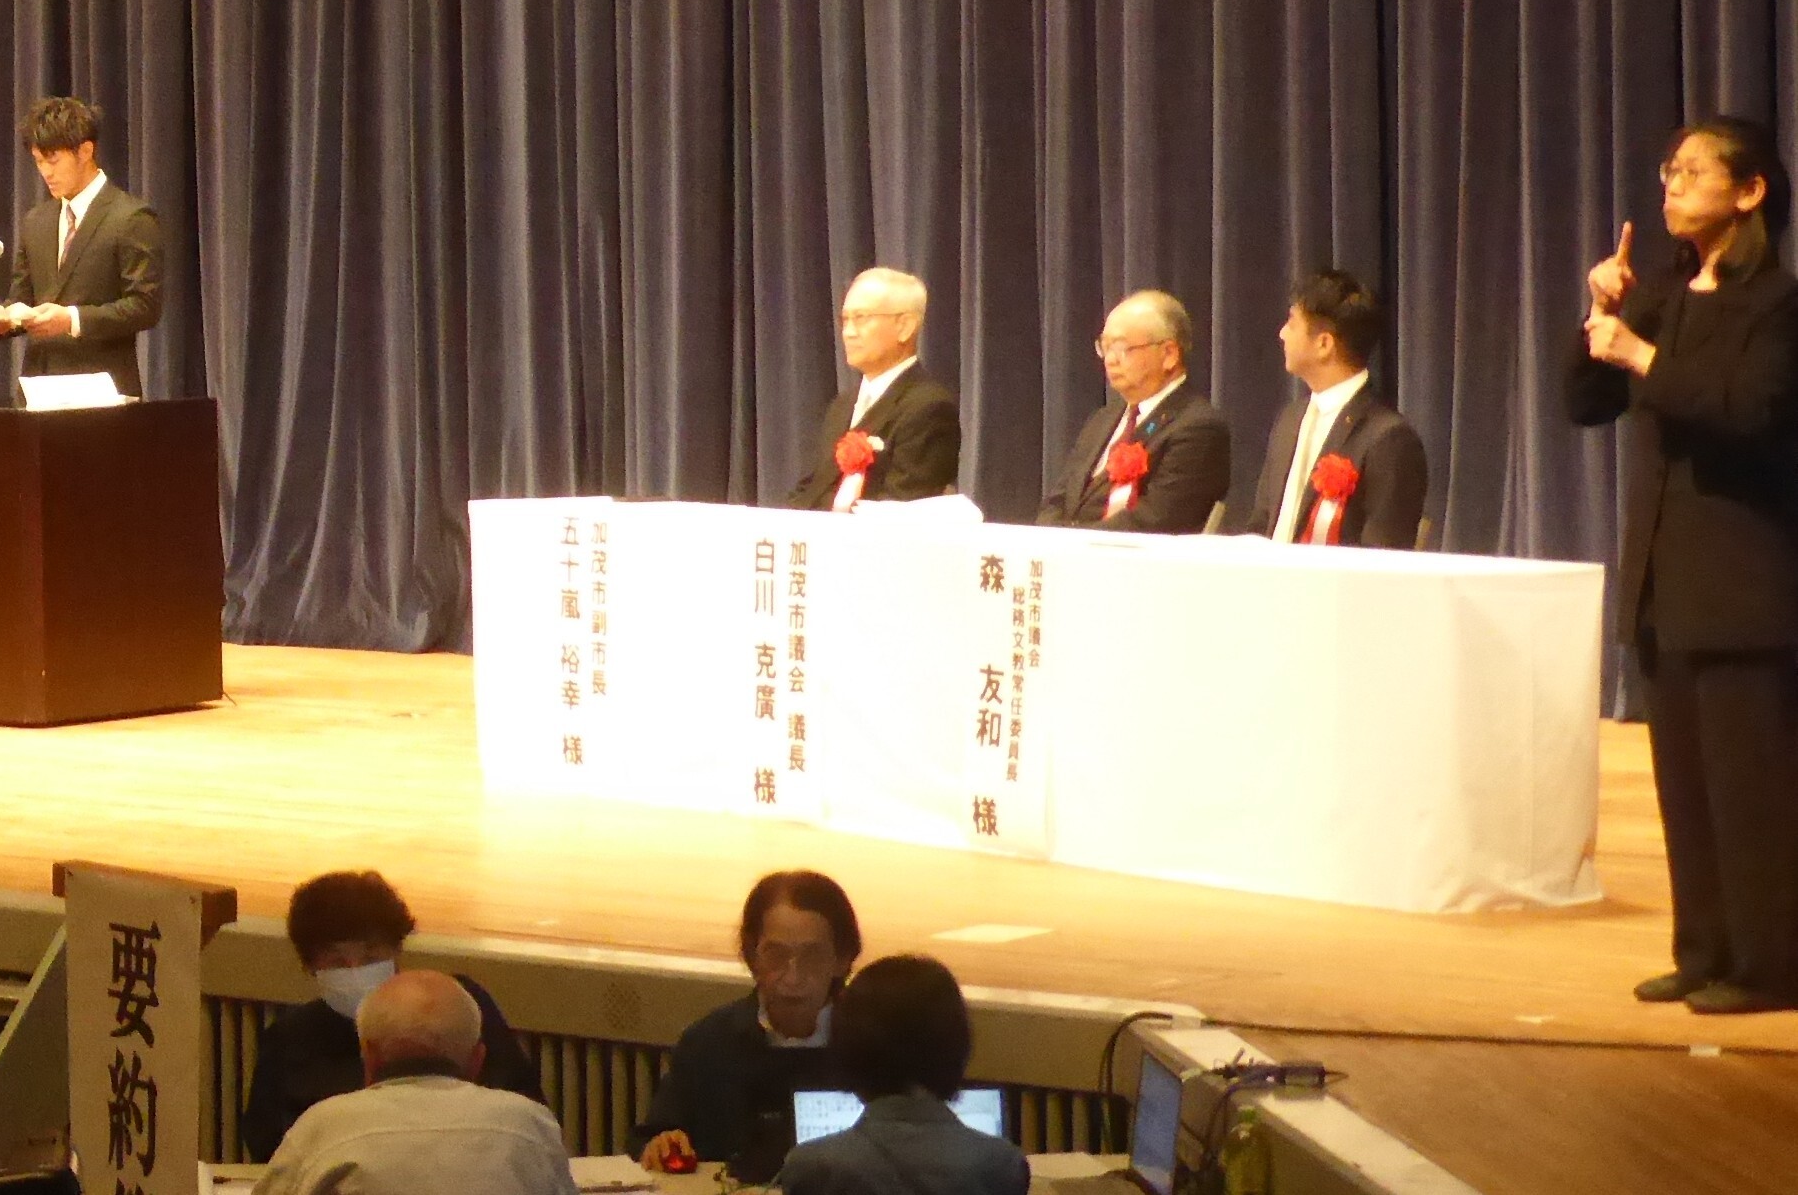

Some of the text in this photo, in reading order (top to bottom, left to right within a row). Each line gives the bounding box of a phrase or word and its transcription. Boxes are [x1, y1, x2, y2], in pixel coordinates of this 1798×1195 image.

[560, 517, 583, 765] 五十嵐 裕幸 様
[591, 522, 608, 696] 加茂市副市長
[753, 538, 777, 805] 白川 克廣 様
[788, 541, 807, 772] 加茂市議会 議長
[972, 554, 1005, 837] 森 友和 様
[1027, 559, 1043, 668] 加茂市議会
[107, 920, 162, 1195] 要約
